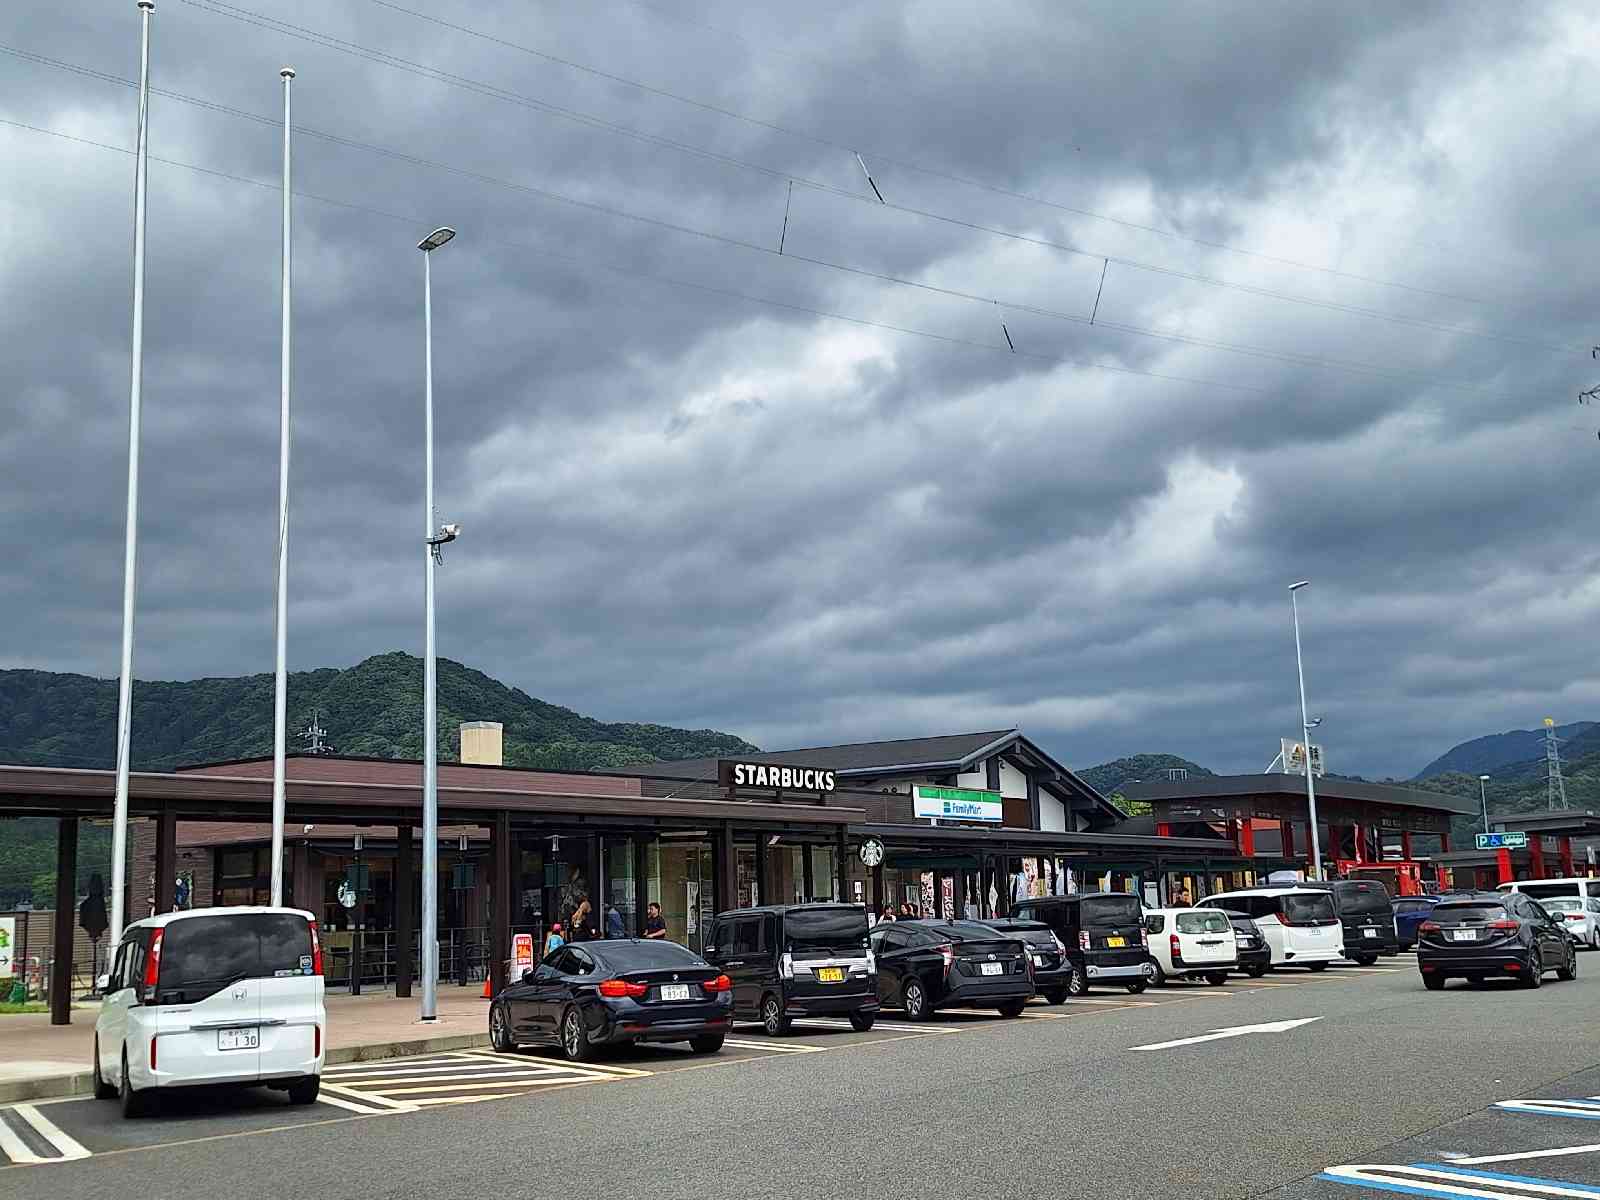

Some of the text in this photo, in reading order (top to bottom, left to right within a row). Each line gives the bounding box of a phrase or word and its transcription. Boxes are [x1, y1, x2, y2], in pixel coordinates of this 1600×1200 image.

[734, 763, 835, 791] STARBUCKS
[952, 802, 982, 815] FamilyMart
[1479, 835, 1488, 847] P
